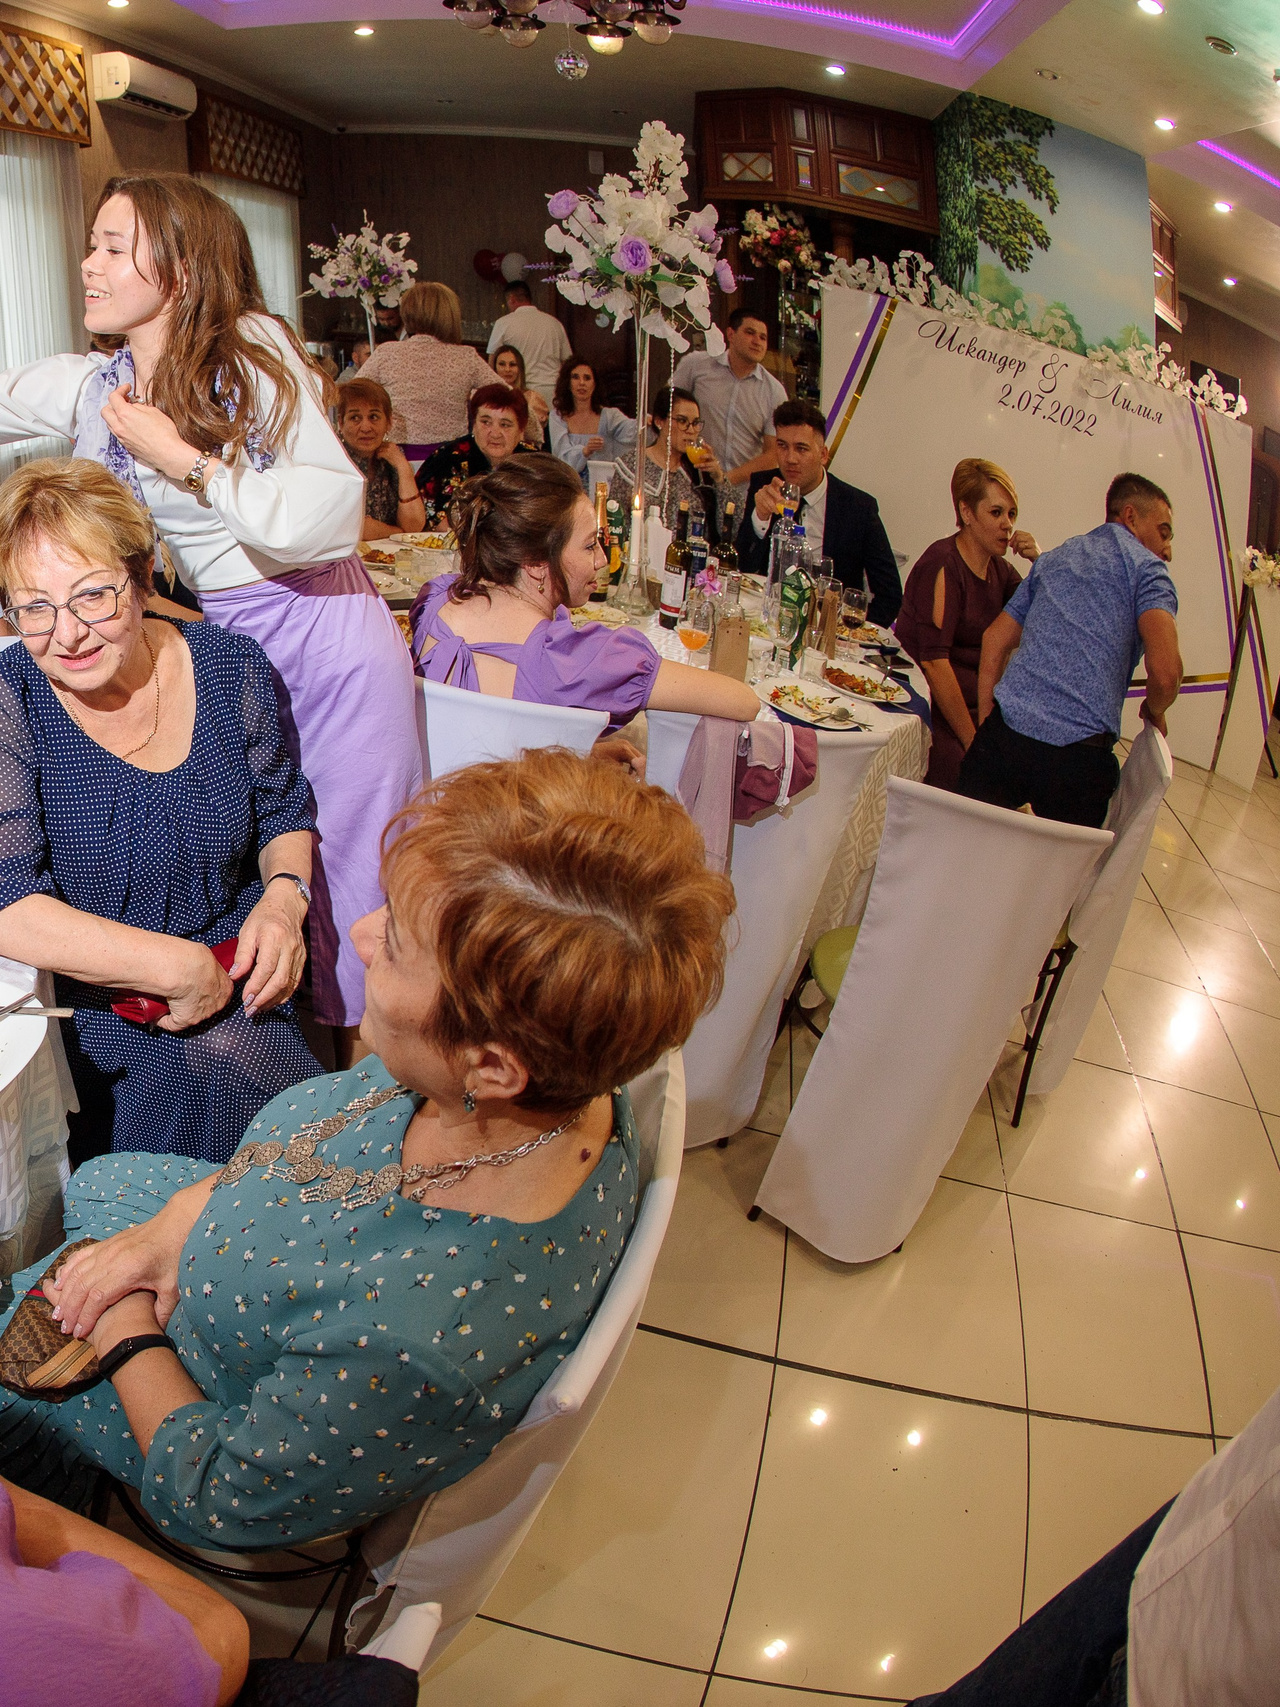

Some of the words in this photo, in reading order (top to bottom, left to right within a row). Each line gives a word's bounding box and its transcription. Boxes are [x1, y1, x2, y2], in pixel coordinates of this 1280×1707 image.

[917, 319, 1028, 378] Искандер
[1037, 353, 1069, 394] &
[1085, 378, 1164, 425] Лилия
[997, 383, 1098, 438] 2.07.2022
